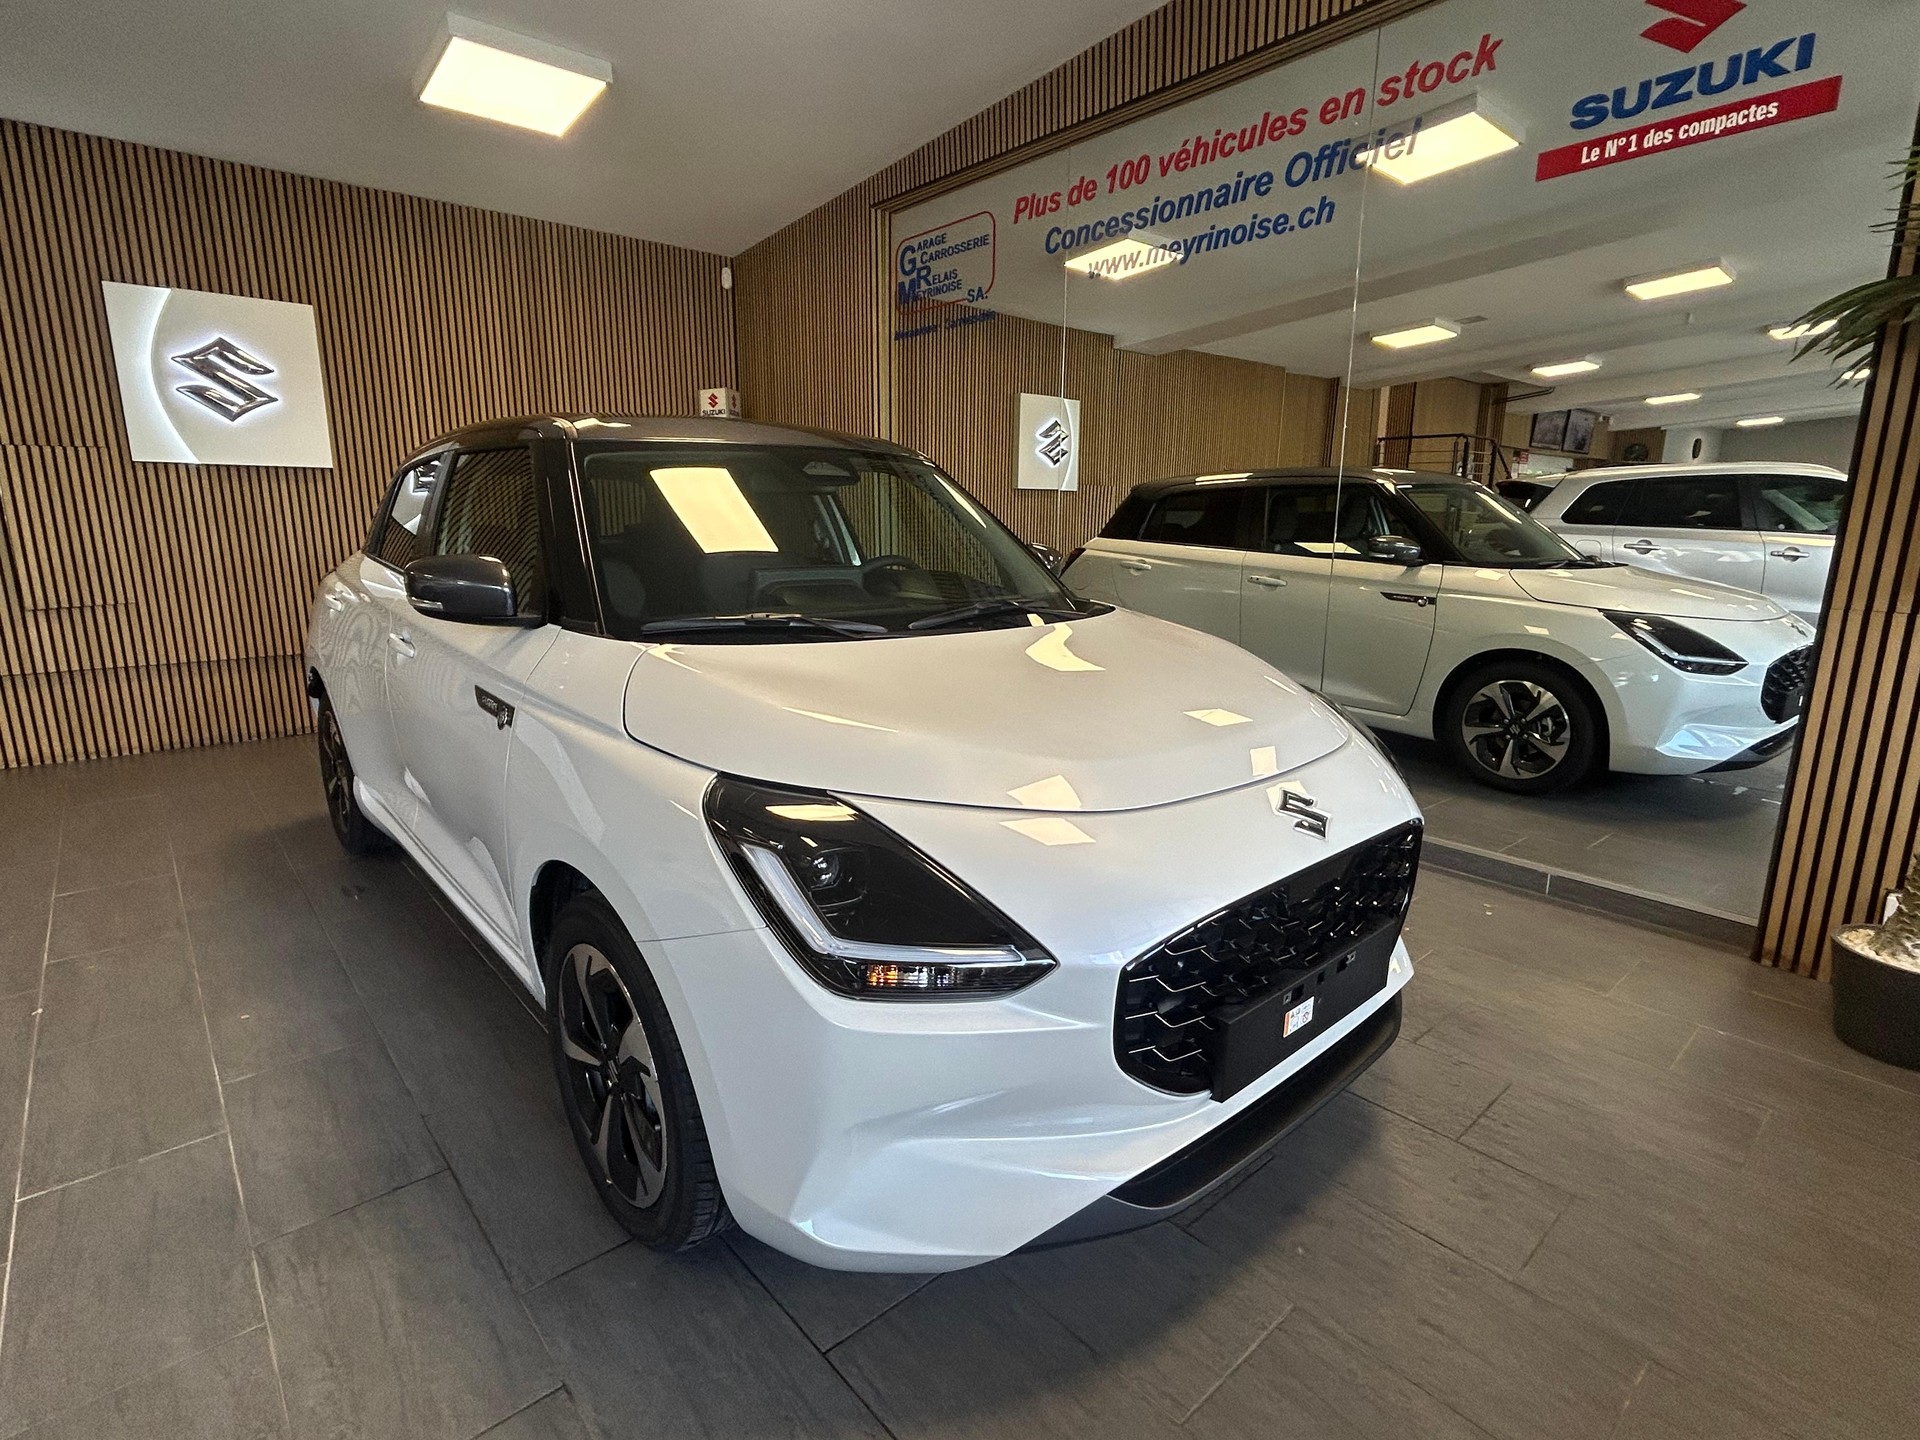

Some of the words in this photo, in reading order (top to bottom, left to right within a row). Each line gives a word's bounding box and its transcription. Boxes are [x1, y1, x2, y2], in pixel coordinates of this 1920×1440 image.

[1570, 32, 1817, 130] SUZUKI
[1013, 191, 1062, 225] Plus
[1067, 175, 1098, 207] de
[1106, 154, 1151, 194] 100
[1158, 107, 1309, 177] véhicules
[1319, 86, 1366, 125] en
[1376, 33, 1504, 107] stock
[1580, 145, 1600, 165] Le
[1604, 134, 1638, 160] N°1
[1643, 122, 1674, 149] des
[1678, 99, 1779, 141] compactes
[1045, 170, 1275, 255] Concessionnaire
[1284, 116, 1423, 188] Officiel
[899, 233, 948, 277] GARAGE
[920, 234, 990, 265] CARROSSERIE
[1088, 196, 1335, 280] www.meyrinoise.ch
[898, 278, 963, 305] MEYRINOISE
[916, 265, 958, 290] RELAIS
